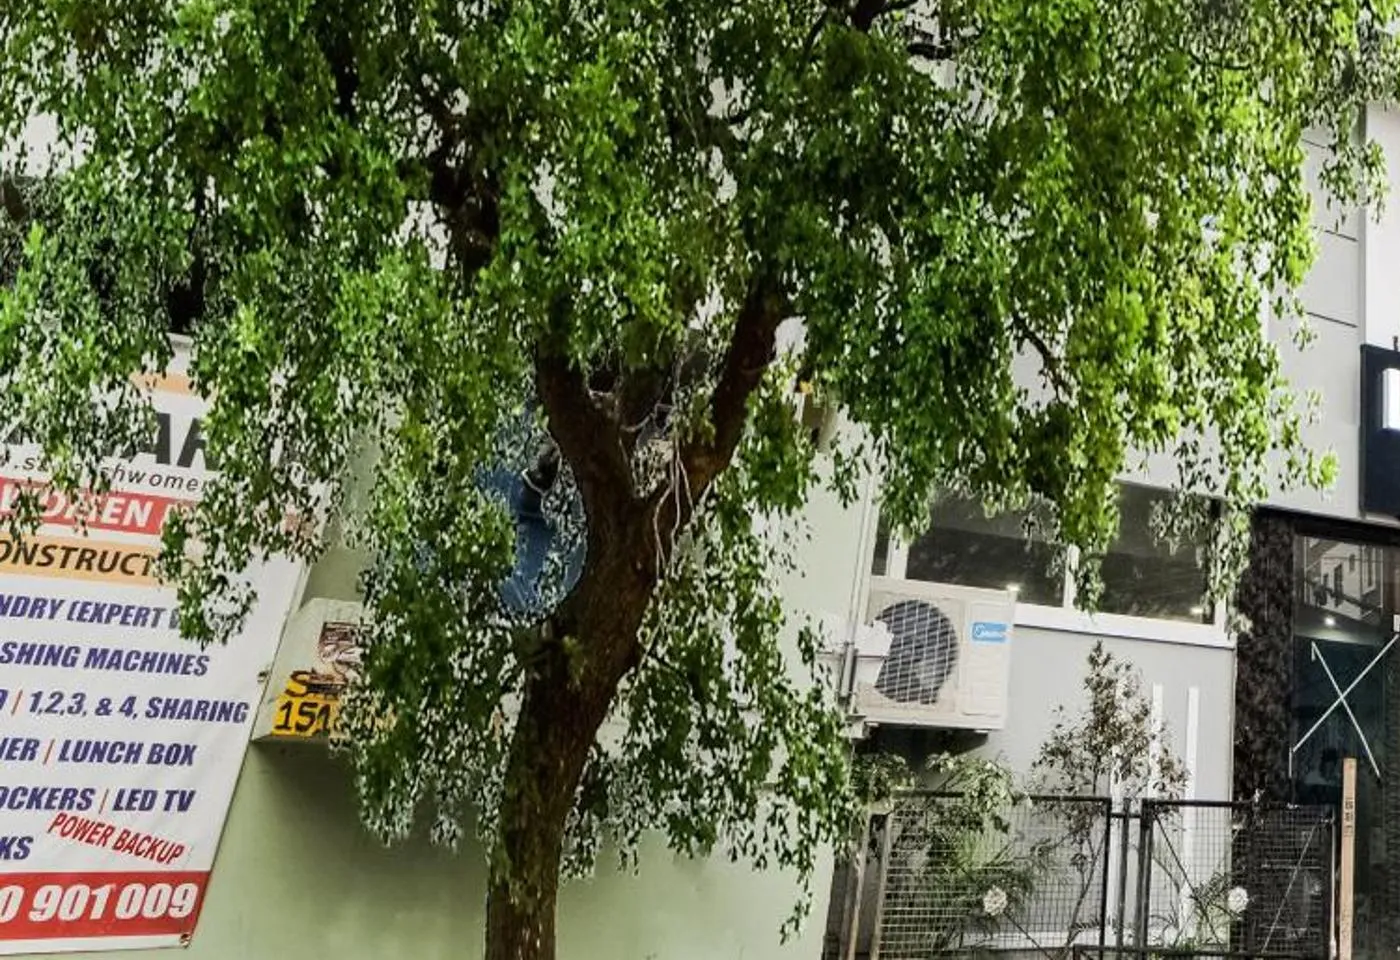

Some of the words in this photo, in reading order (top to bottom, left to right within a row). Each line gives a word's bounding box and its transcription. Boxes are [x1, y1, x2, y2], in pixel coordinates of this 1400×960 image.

[0, 641, 81, 668] SHING
[84, 647, 210, 677] MACHINES
[95, 698, 112, 717] &
[145, 696, 250, 724] SHARING
[58, 739, 144, 764] LUNCH
[146, 743, 197, 767] BOX
[112, 789, 158, 812] LED
[163, 790, 196, 812] TV
[48, 813, 115, 848] POWER
[112, 829, 185, 865] BACKUP
